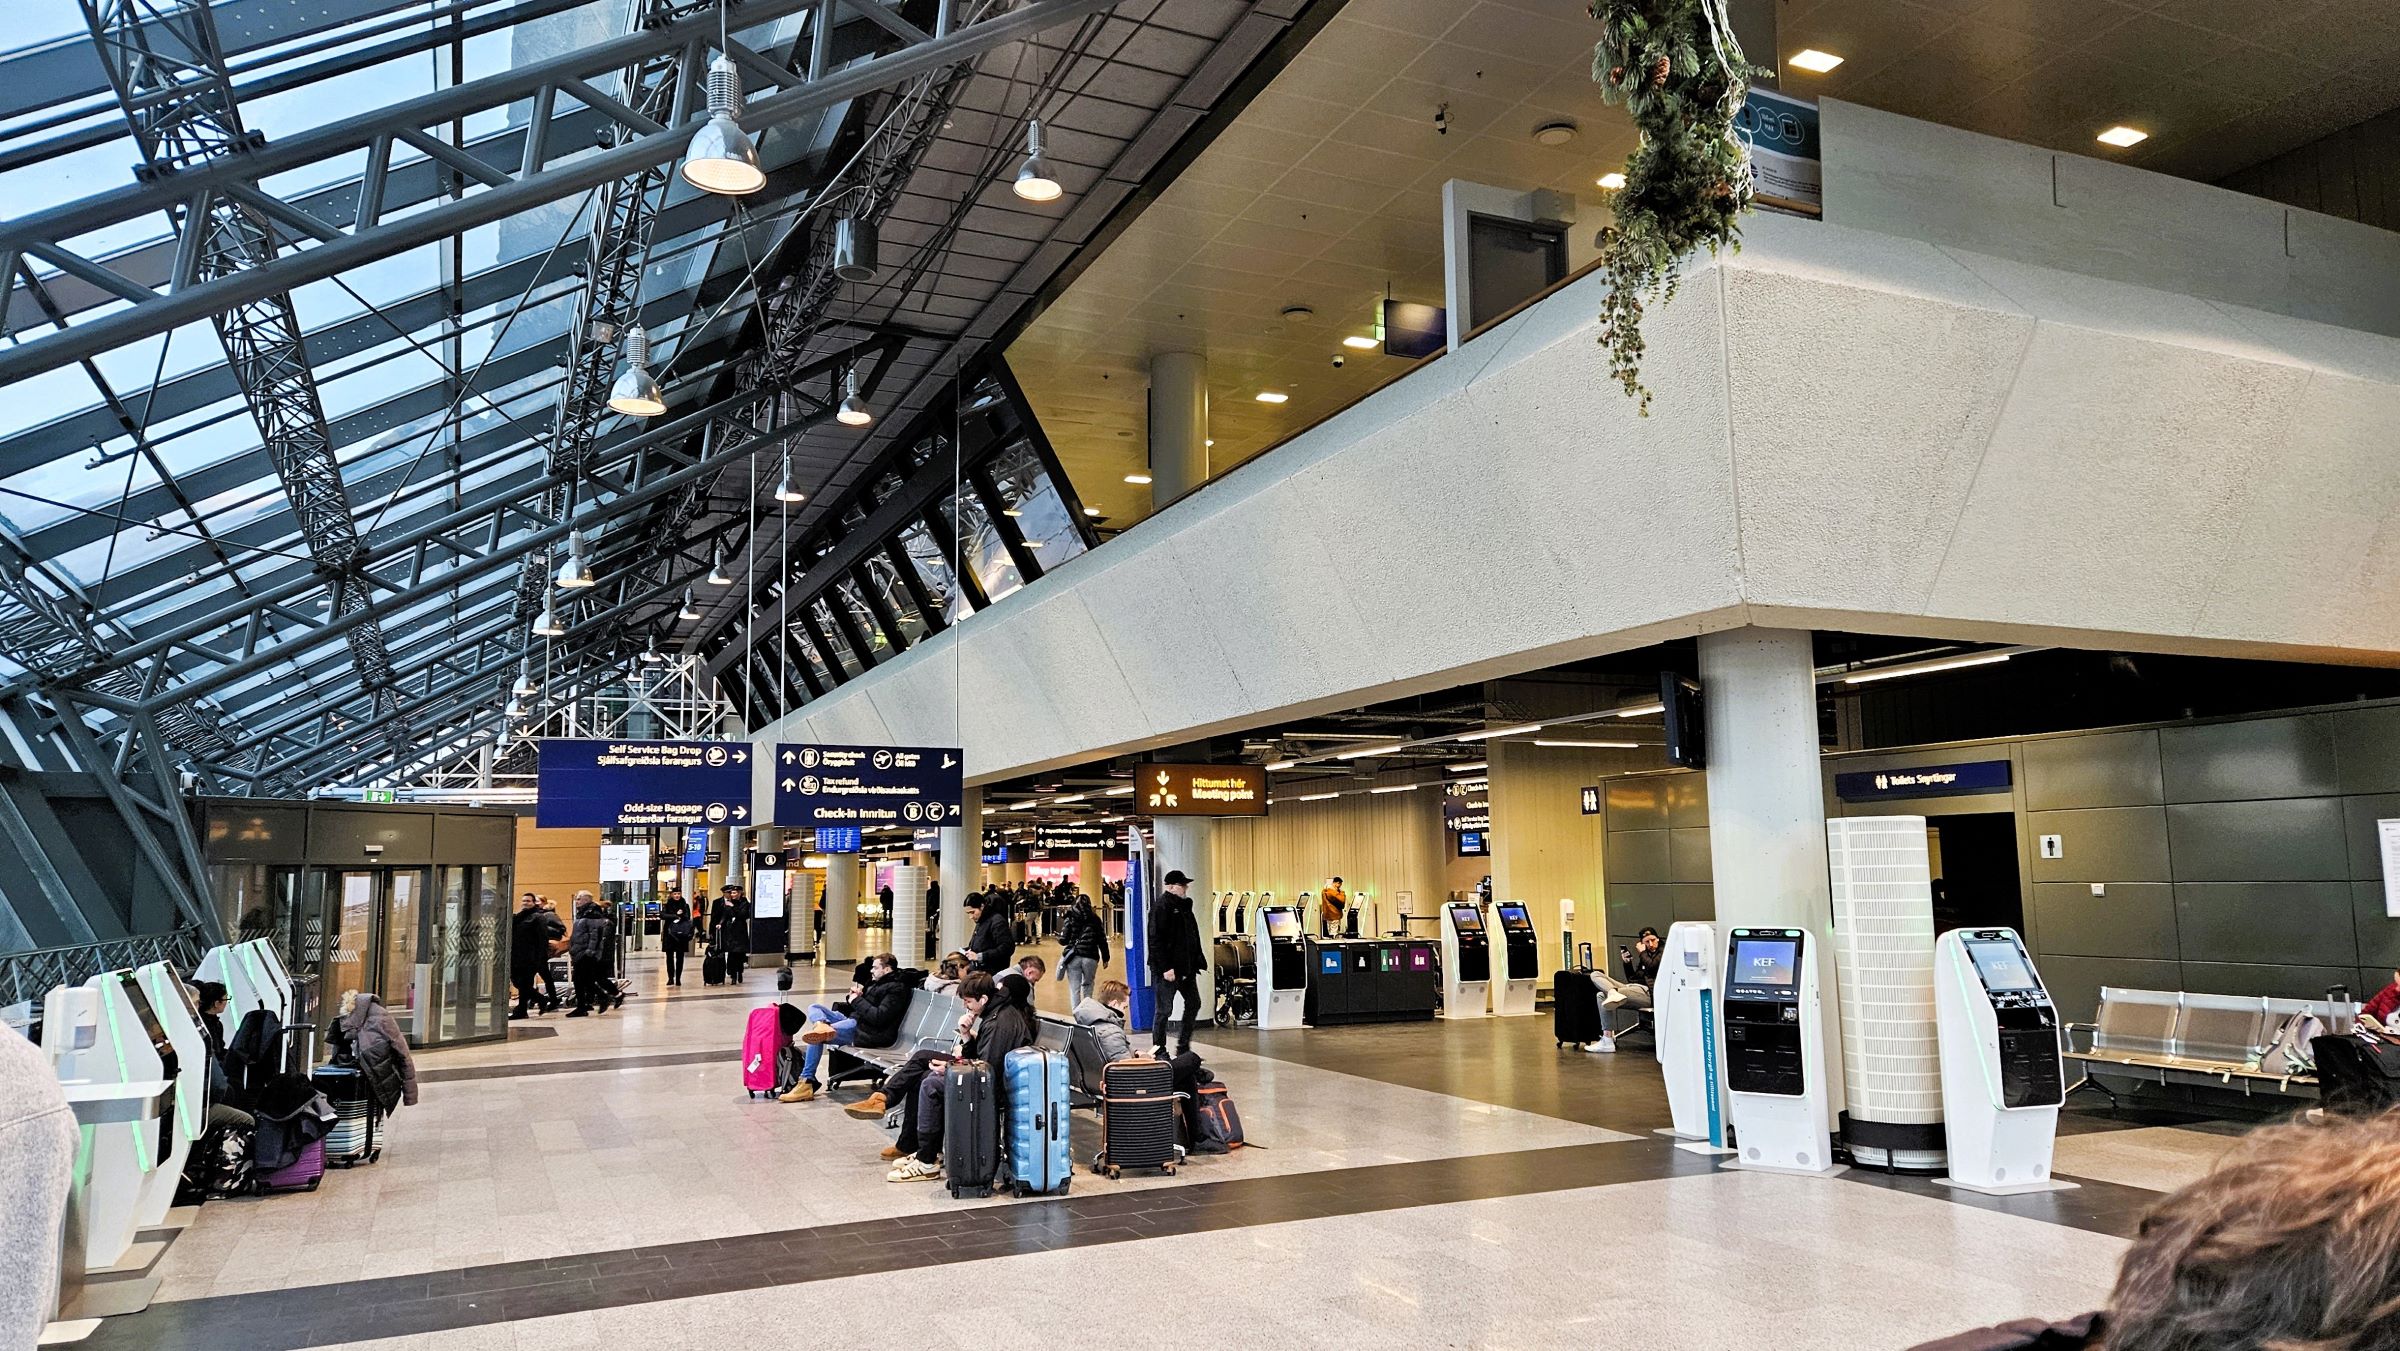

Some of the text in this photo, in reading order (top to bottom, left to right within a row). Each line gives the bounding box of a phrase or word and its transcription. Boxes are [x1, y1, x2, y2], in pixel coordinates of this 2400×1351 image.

[608, 745, 702, 757] Self Service Bag Drop
[597, 755, 702, 767] Sjálfsafgreiðsla farangurs
[822, 777, 859, 786] Tax refund
[1192, 777, 1230, 788] Hittumst
[1890, 775, 1916, 786] Toilets
[1192, 788, 1254, 802] Meeting point
[623, 804, 702, 815] Odd-size Baggage
[814, 807, 939, 819] Check-in Innritun B C
[666, 814, 702, 825] farangur
[1753, 957, 1776, 967] KEF
[1990, 960, 2008, 970] KEF
